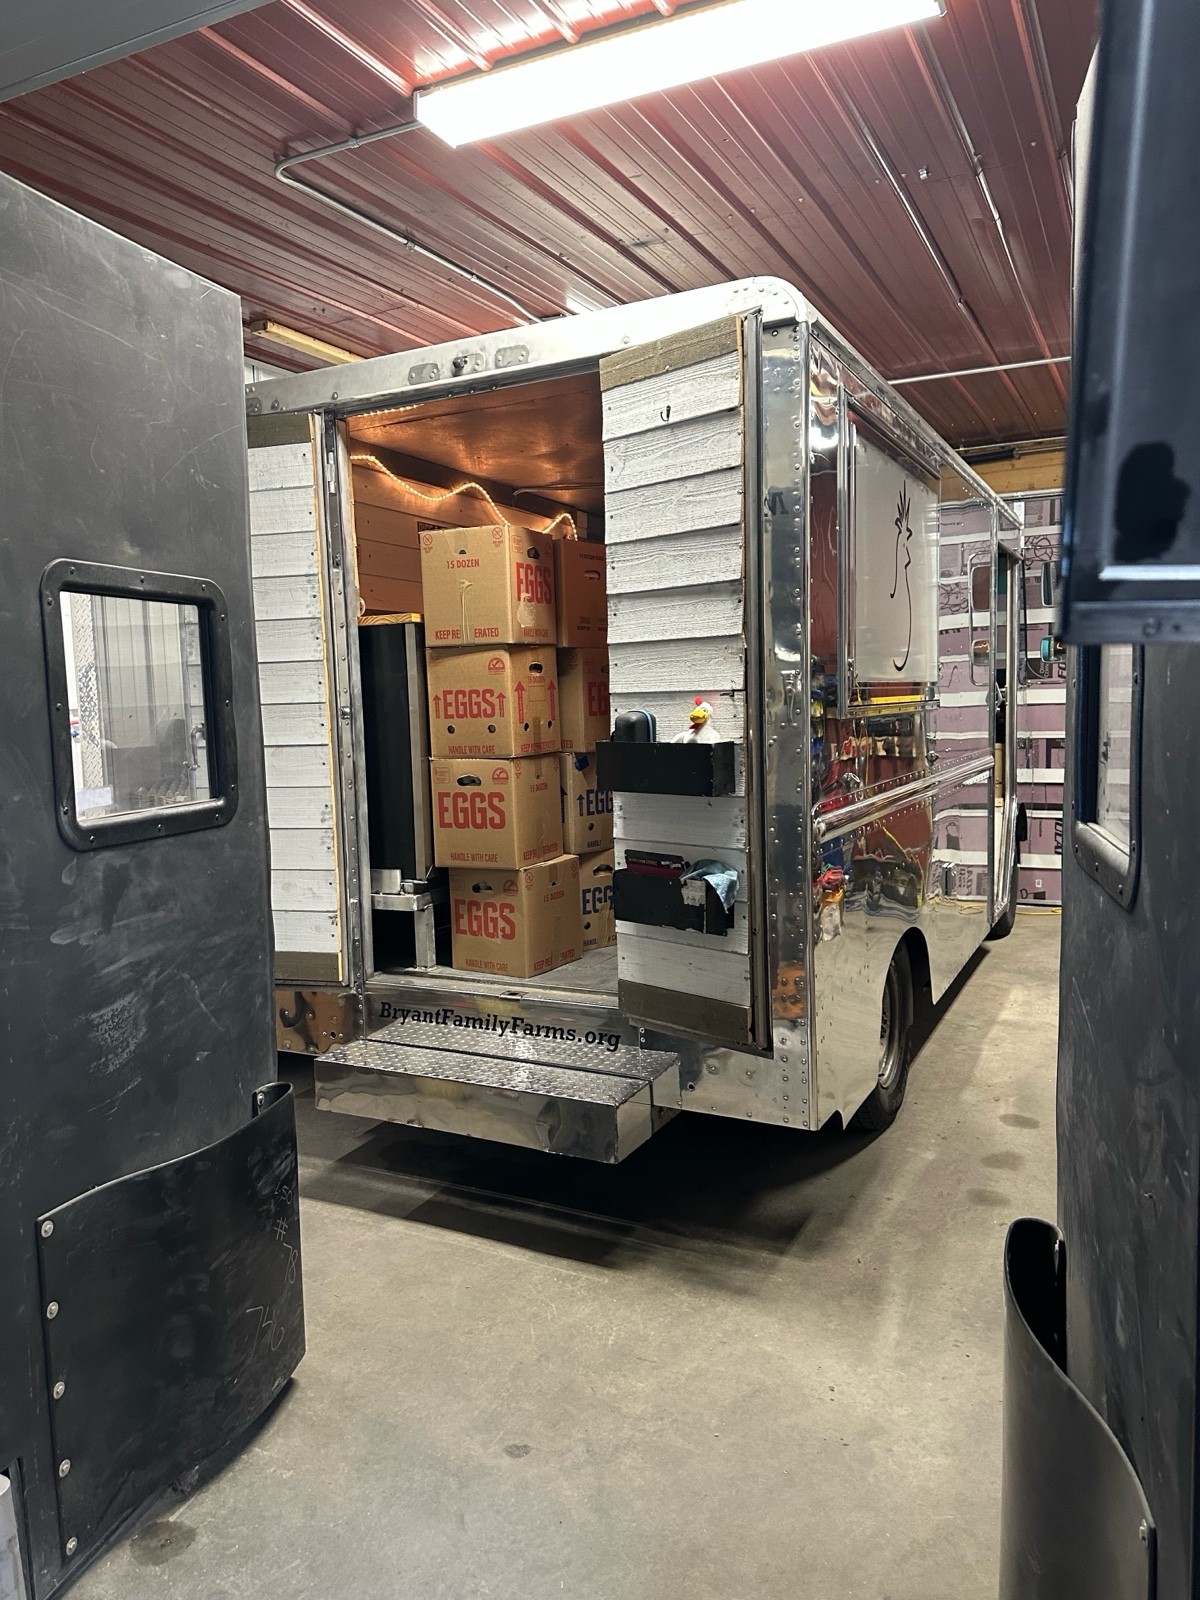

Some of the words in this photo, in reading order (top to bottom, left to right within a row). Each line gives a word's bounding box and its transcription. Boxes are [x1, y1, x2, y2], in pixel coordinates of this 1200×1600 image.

[446, 560, 454, 569] 15
[456, 558, 480, 568] DOZEN
[435, 629, 450, 640] KEEP
[442, 688, 496, 720] EGGS
[587, 681, 608, 717] EG
[448, 745, 467, 755] HANDLE
[468, 745, 481, 754] WITH
[482, 744, 495, 754] CARE
[437, 791, 507, 830] EGGS
[586, 789, 613, 816] EGG
[450, 852, 470, 861] HANDLE
[471, 852, 484, 862] WITH
[485, 853, 498, 863] CARE
[543, 895, 549, 903] 15
[550, 889, 565, 900] DOZEN
[582, 885, 613, 915] EGG
[454, 898, 516, 940] EGGS
[465, 957, 483, 968] HANDLE
[483, 960, 496, 970] WITH
[496, 962, 509, 972] CARE
[379, 1001, 621, 1051] BryantFamilyFarms.org
